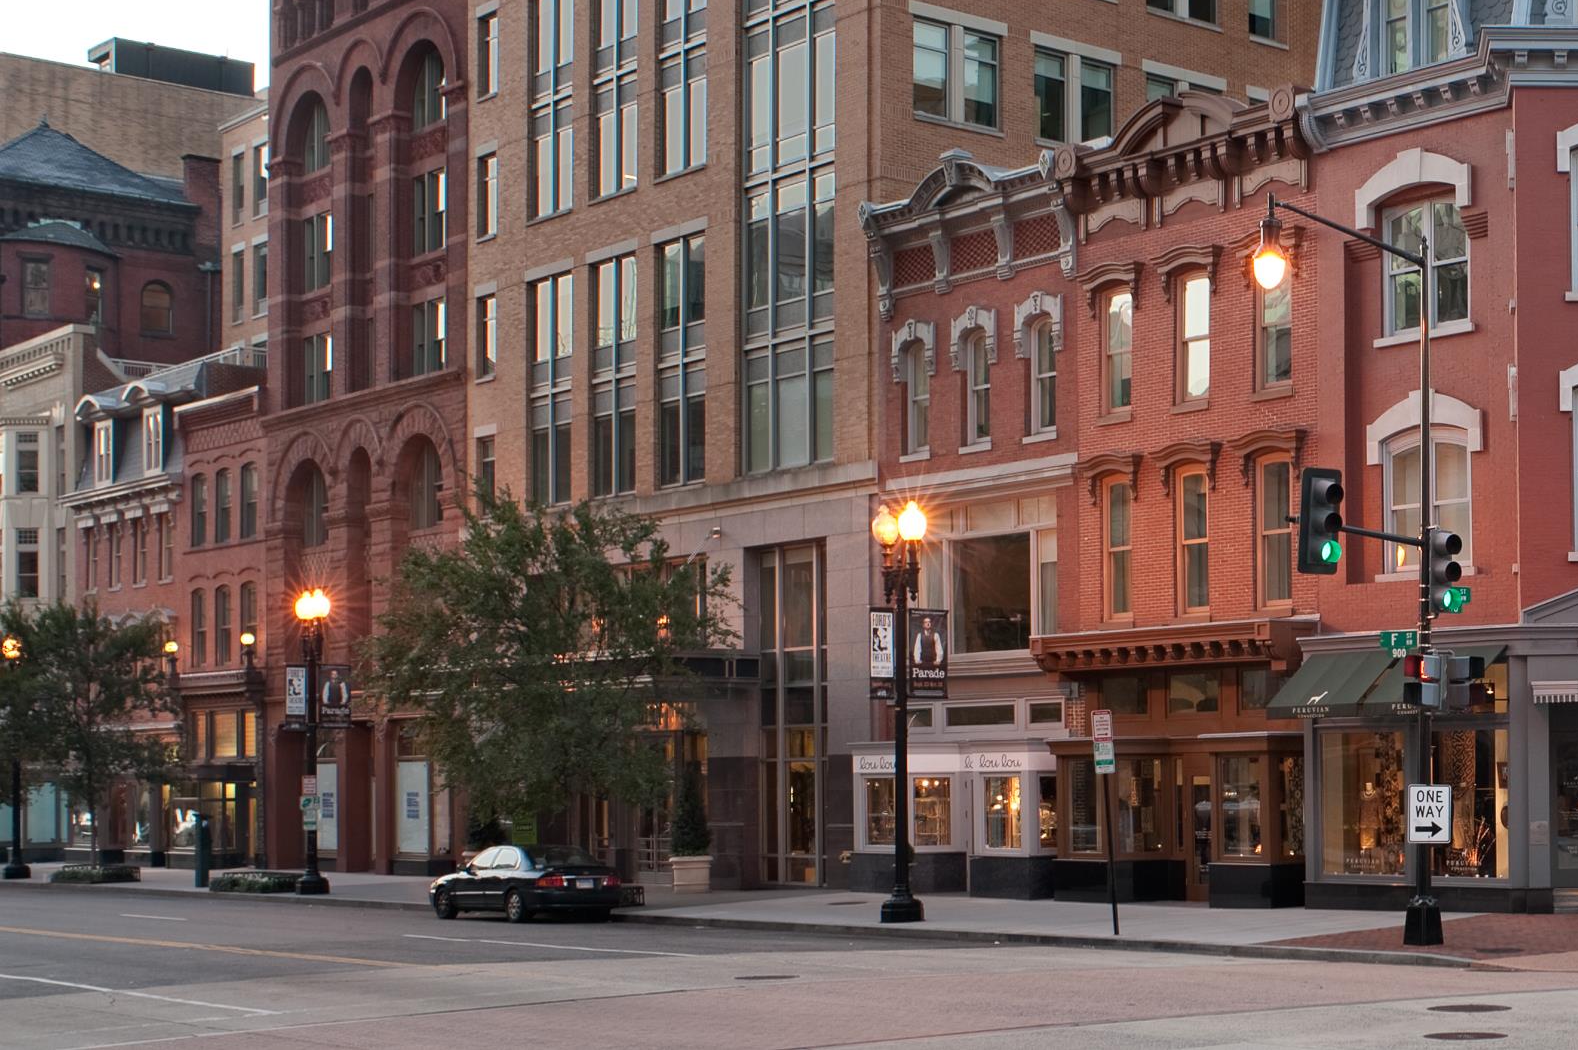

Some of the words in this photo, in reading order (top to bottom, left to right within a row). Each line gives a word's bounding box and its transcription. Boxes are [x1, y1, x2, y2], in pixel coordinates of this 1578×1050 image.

[1391, 633, 1398, 646] F
[1392, 648, 1406, 657] 900
[912, 667, 945, 678] Parade
[979, 754, 999, 769] lou
[1001, 753, 1022, 768] lou
[1416, 790, 1443, 803] ONE
[1415, 805, 1444, 818] WAY
